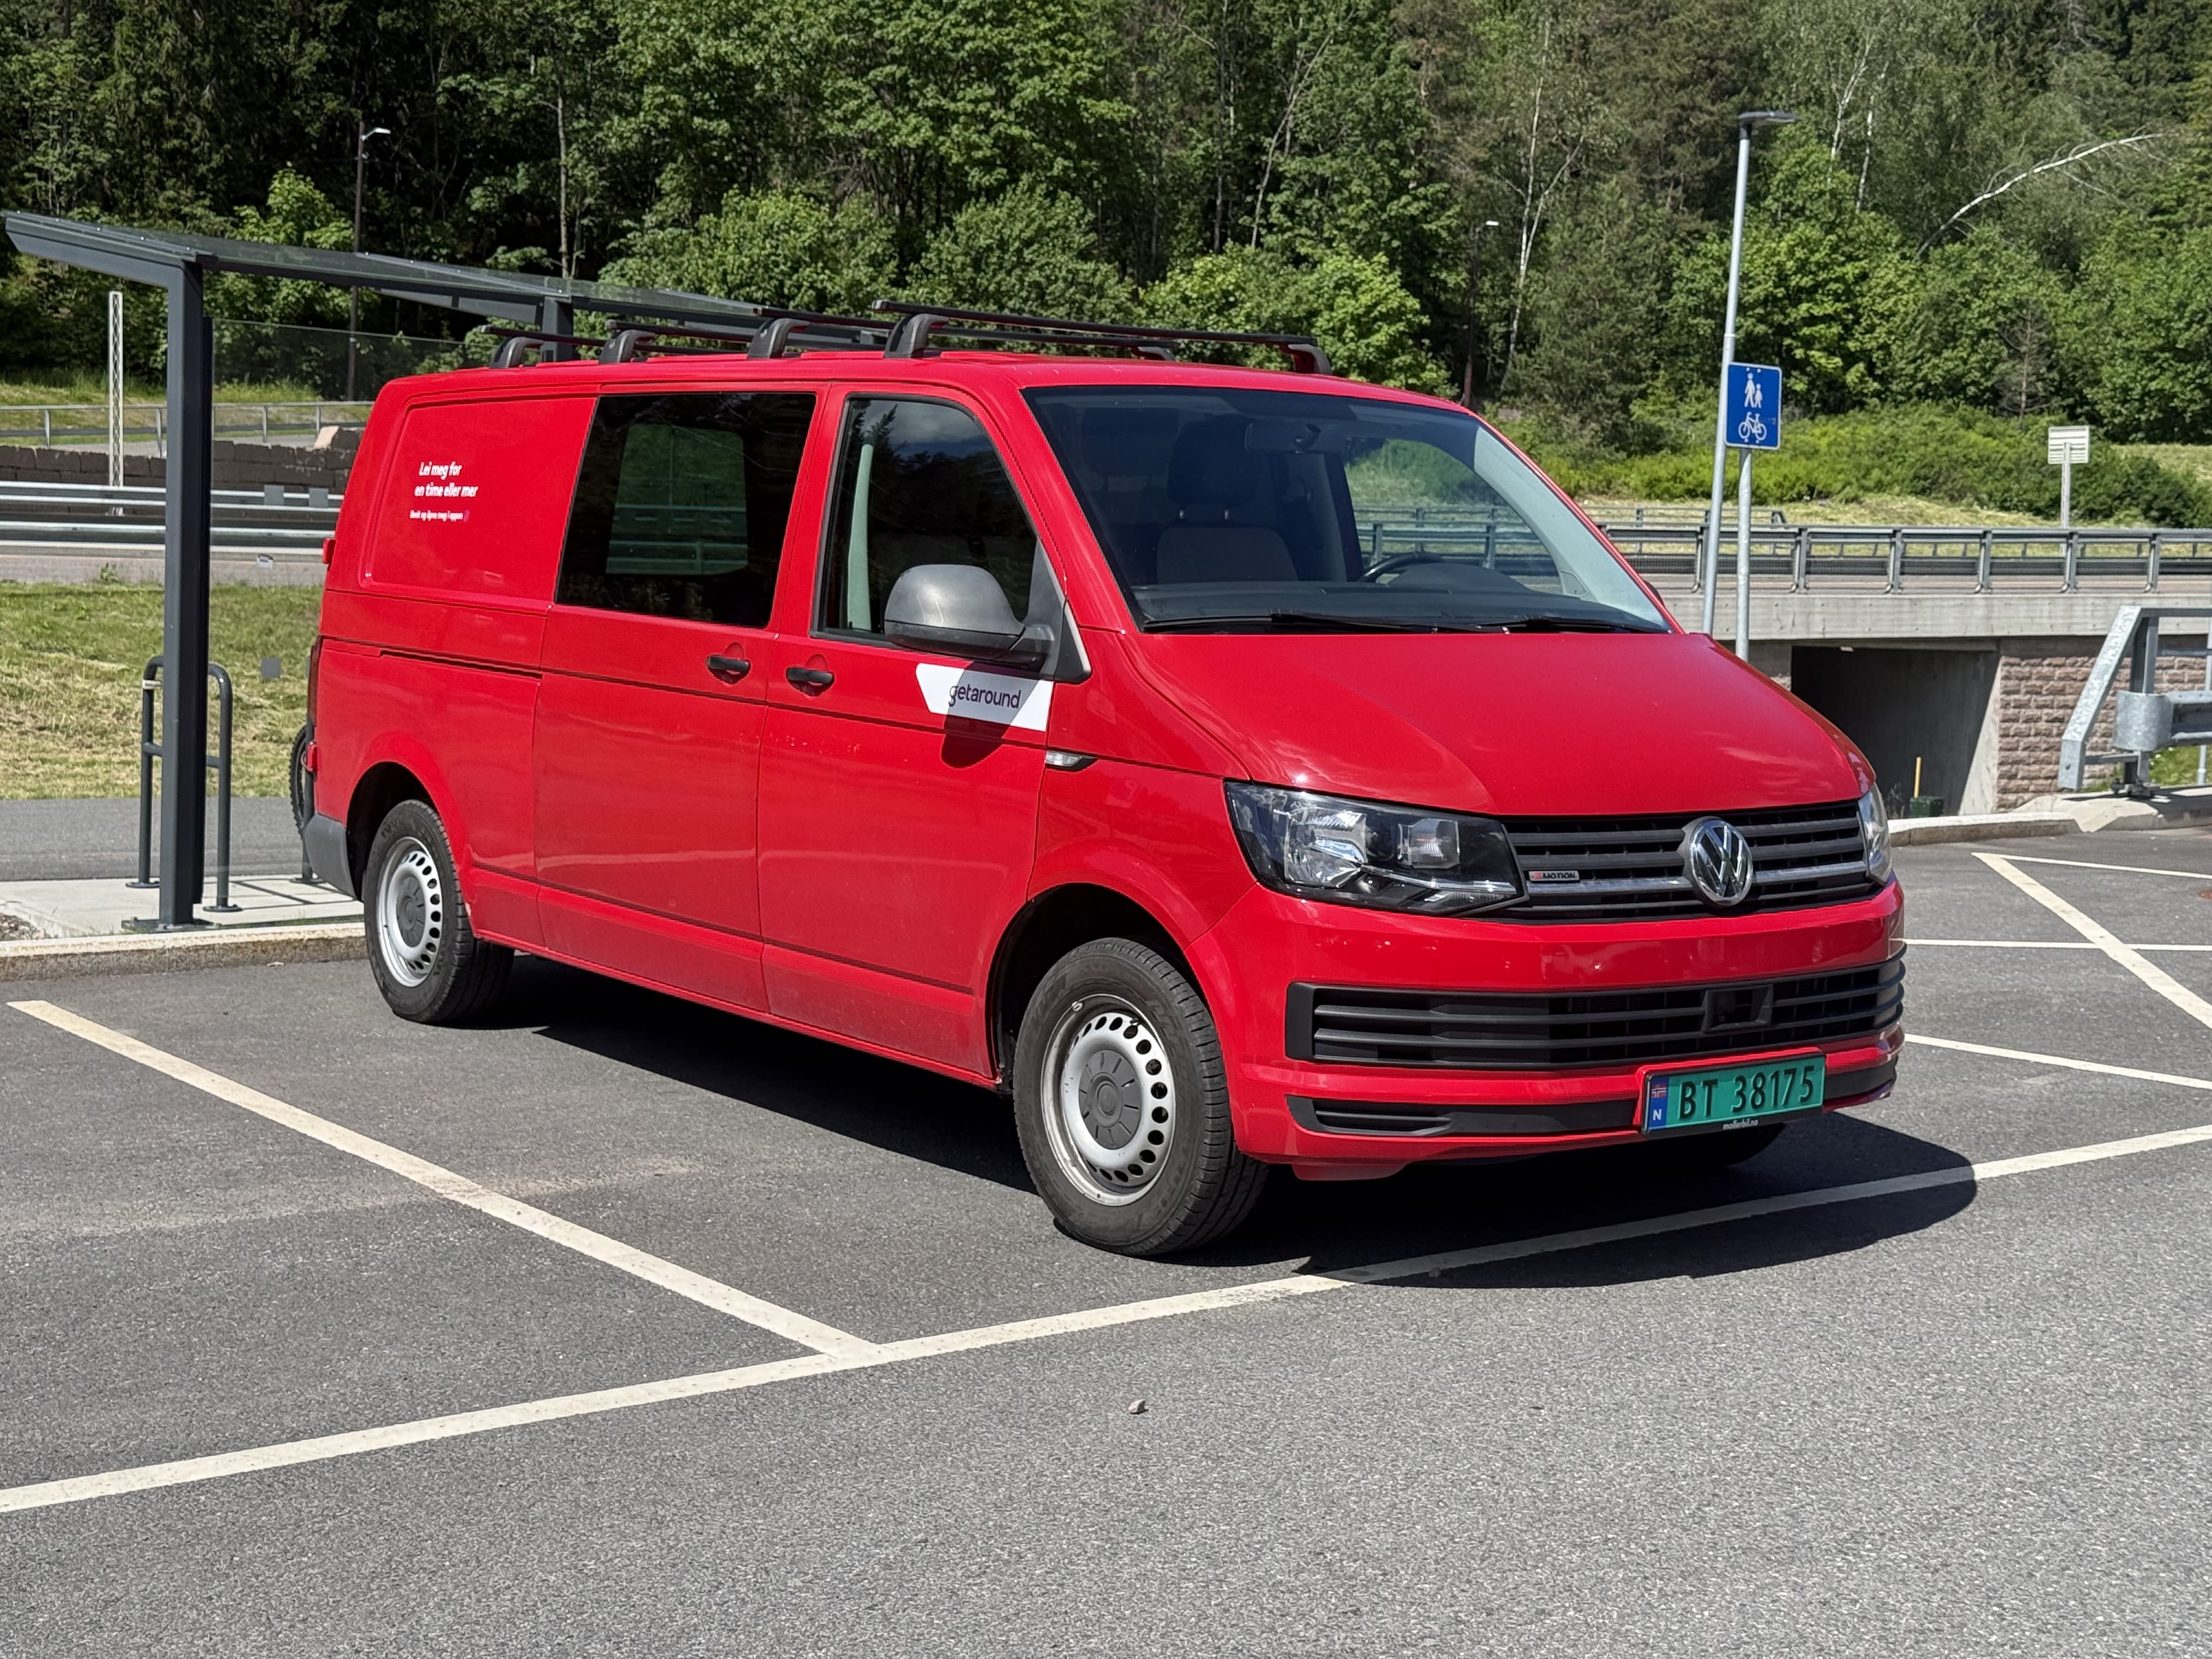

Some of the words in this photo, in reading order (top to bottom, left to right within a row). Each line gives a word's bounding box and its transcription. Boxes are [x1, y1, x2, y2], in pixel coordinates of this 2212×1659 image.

[419, 461, 432, 476] Lei
[431, 465, 449, 480] meg
[448, 461, 462, 476] for
[414, 486, 425, 496] en
[425, 482, 444, 497] time
[443, 482, 461, 497] eller
[461, 486, 478, 497] mer
[949, 684, 1022, 709] getaround
[1678, 1079, 1718, 1120] BT
[1730, 1066, 1814, 1113] 38175
[1652, 1109, 1662, 1121] N
